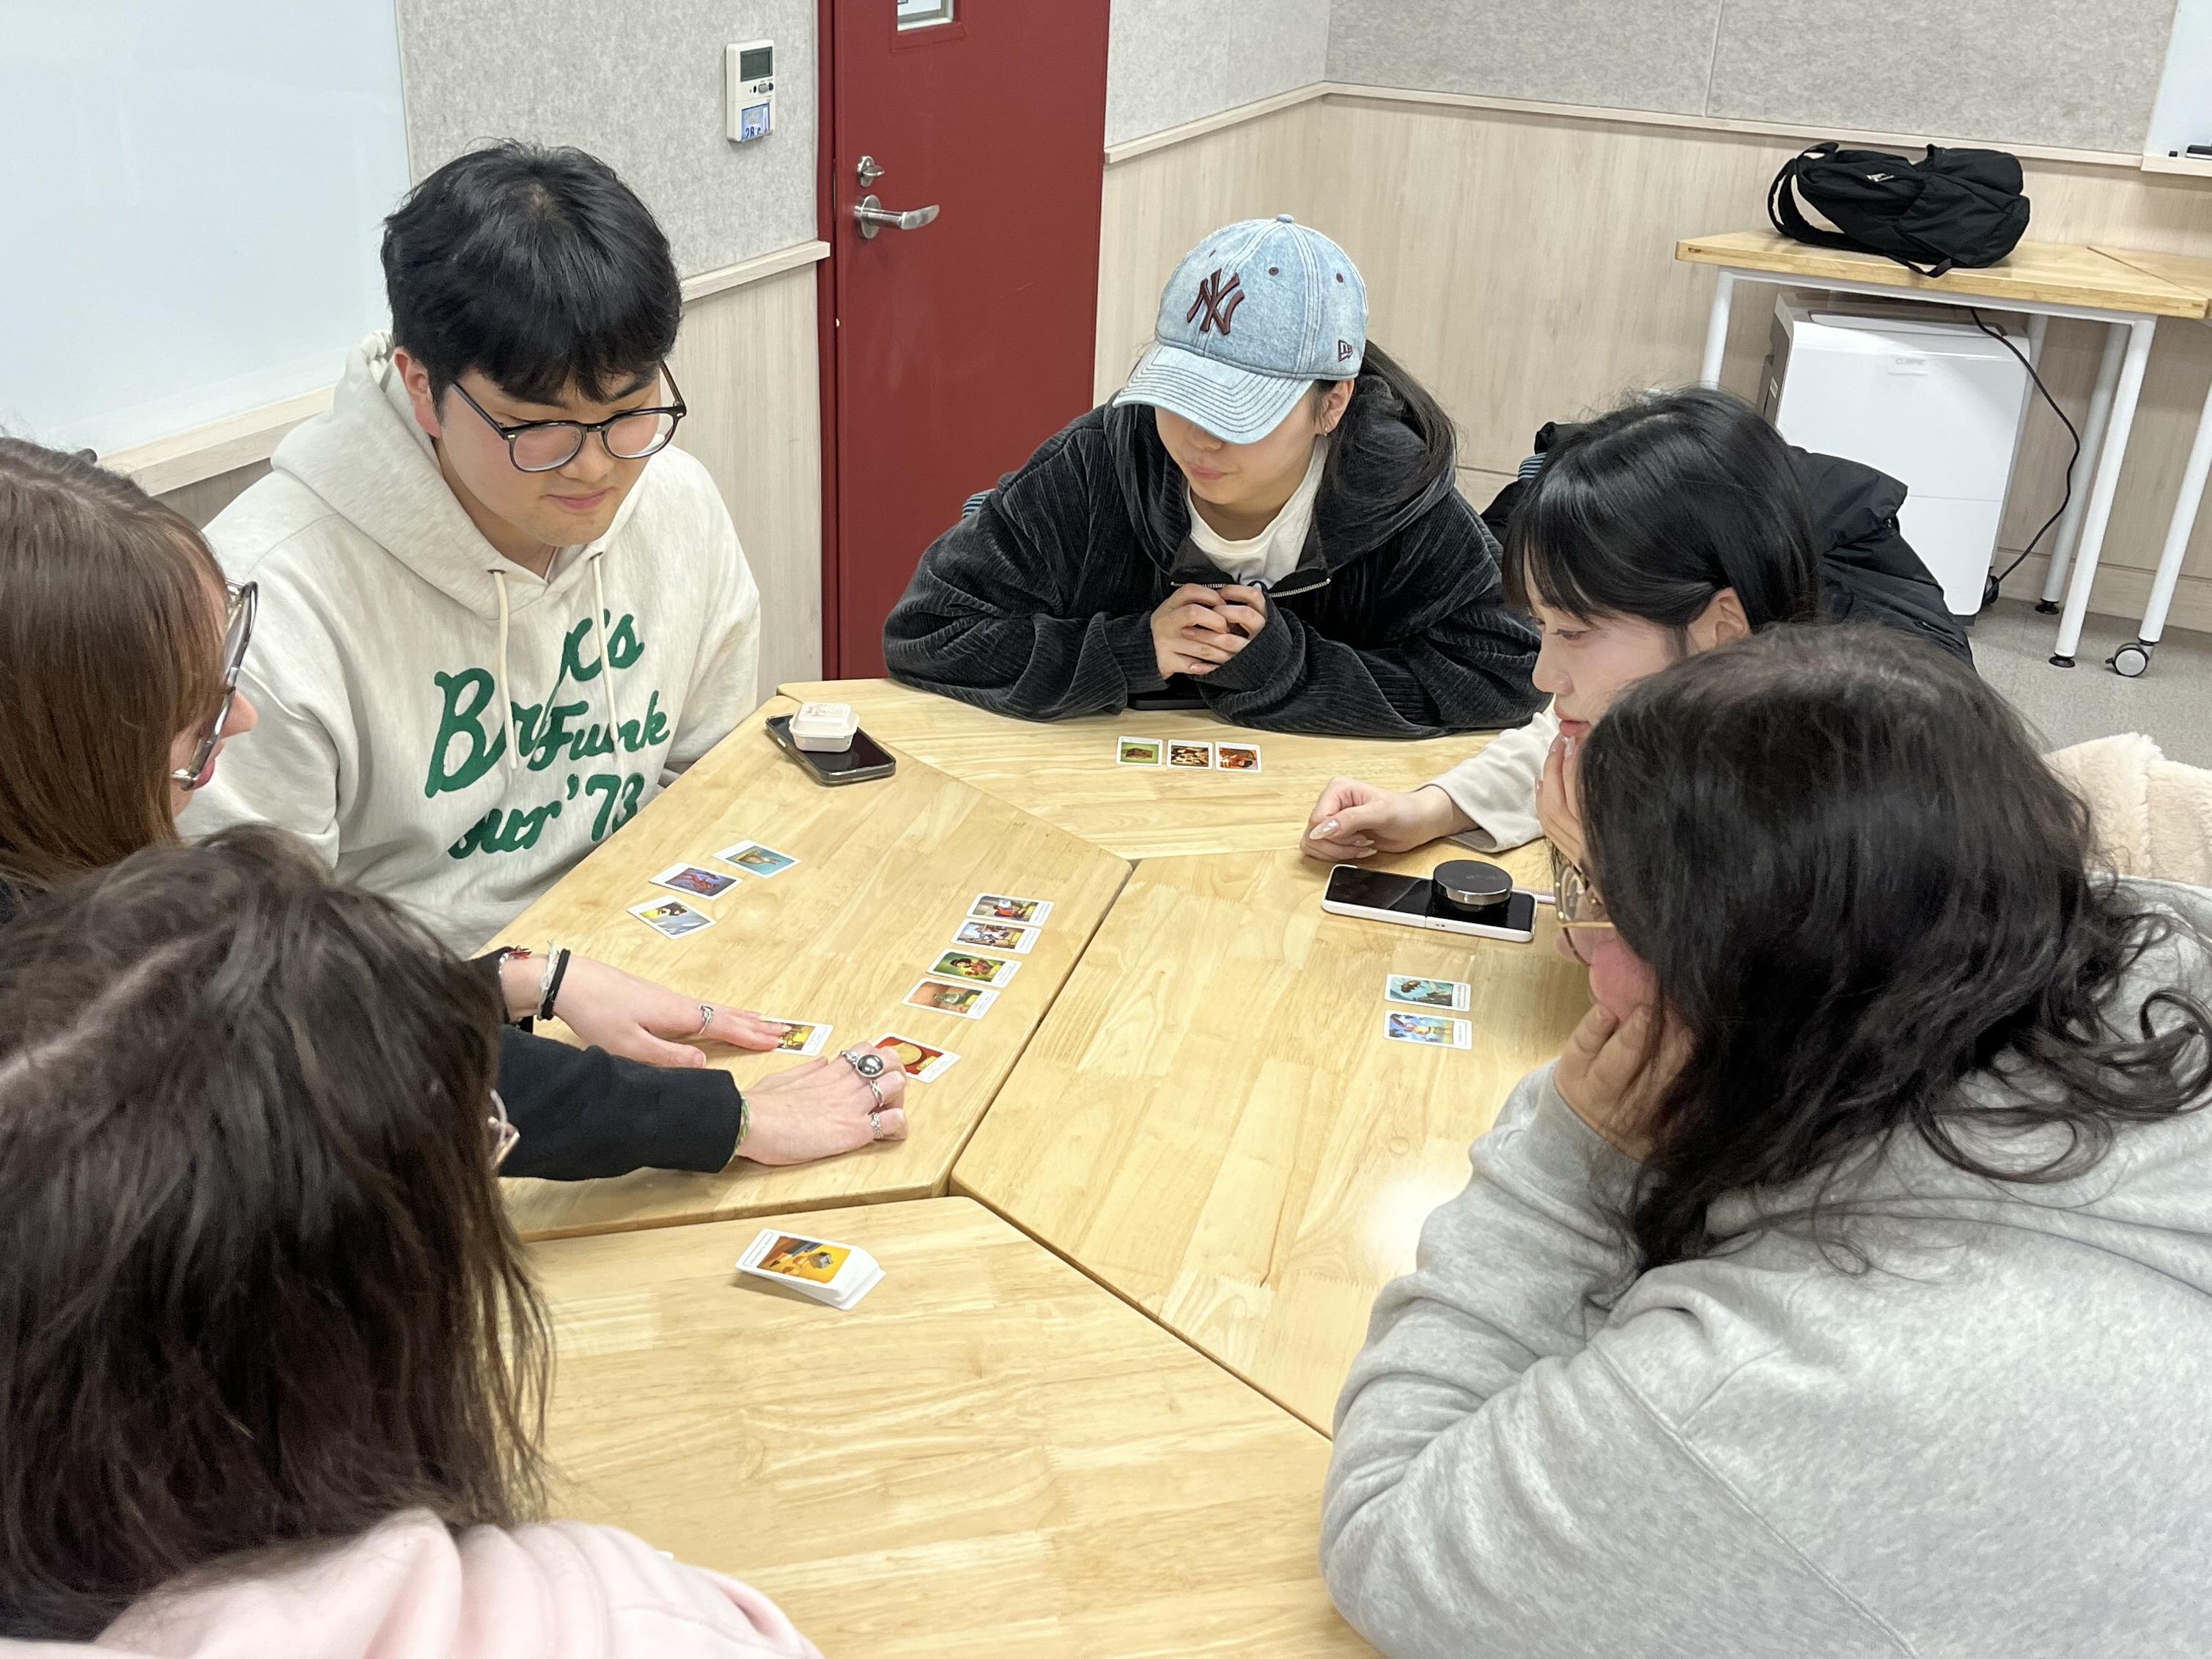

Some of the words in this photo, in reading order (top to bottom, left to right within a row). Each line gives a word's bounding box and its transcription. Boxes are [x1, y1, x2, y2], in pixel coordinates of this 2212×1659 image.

[1187, 267, 1245, 336] NY
[526, 690, 671, 772] Funk
[567, 772, 645, 842] '73
